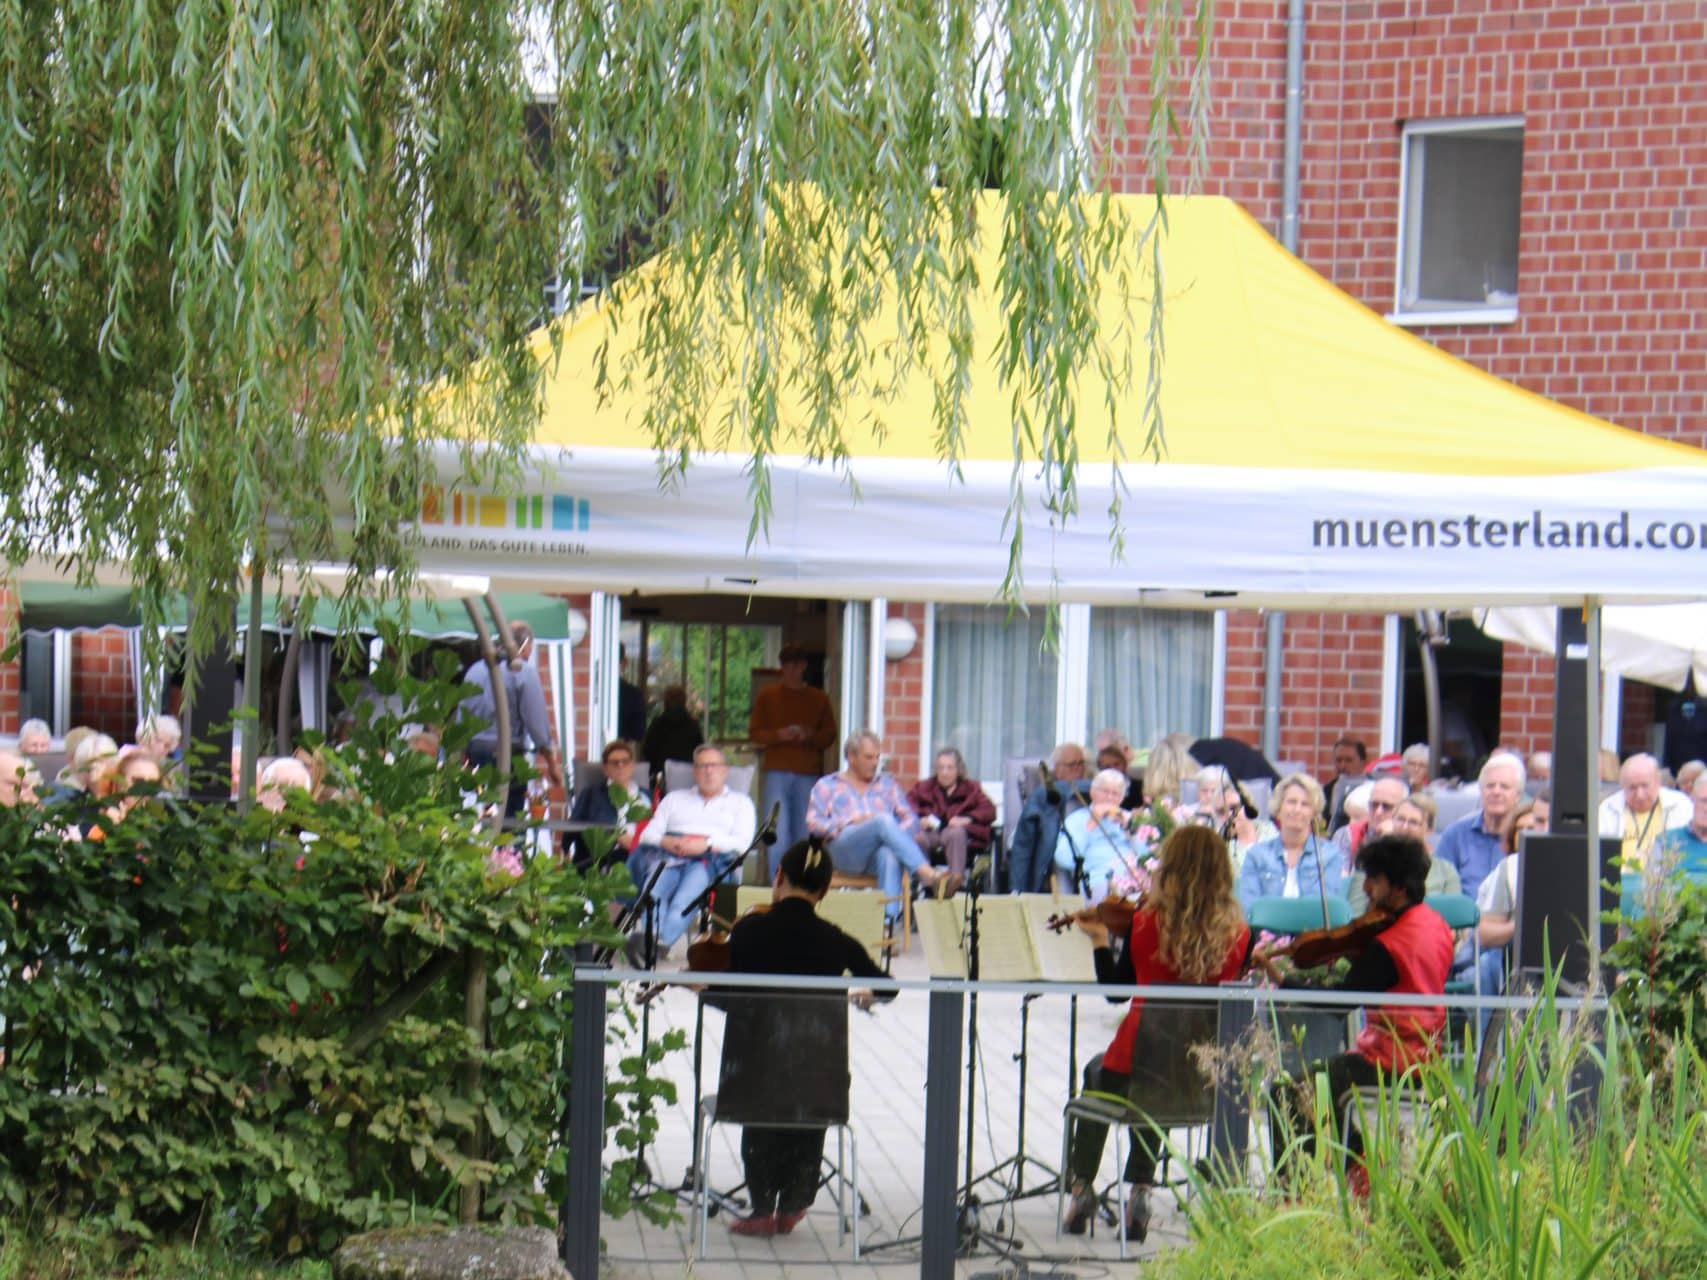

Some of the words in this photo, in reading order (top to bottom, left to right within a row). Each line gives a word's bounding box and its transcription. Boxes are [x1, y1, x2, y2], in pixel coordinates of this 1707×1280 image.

[1312, 510, 1707, 549] muensterland.co
[469, 538, 498, 551] DAS
[500, 540, 536, 553] GUTE
